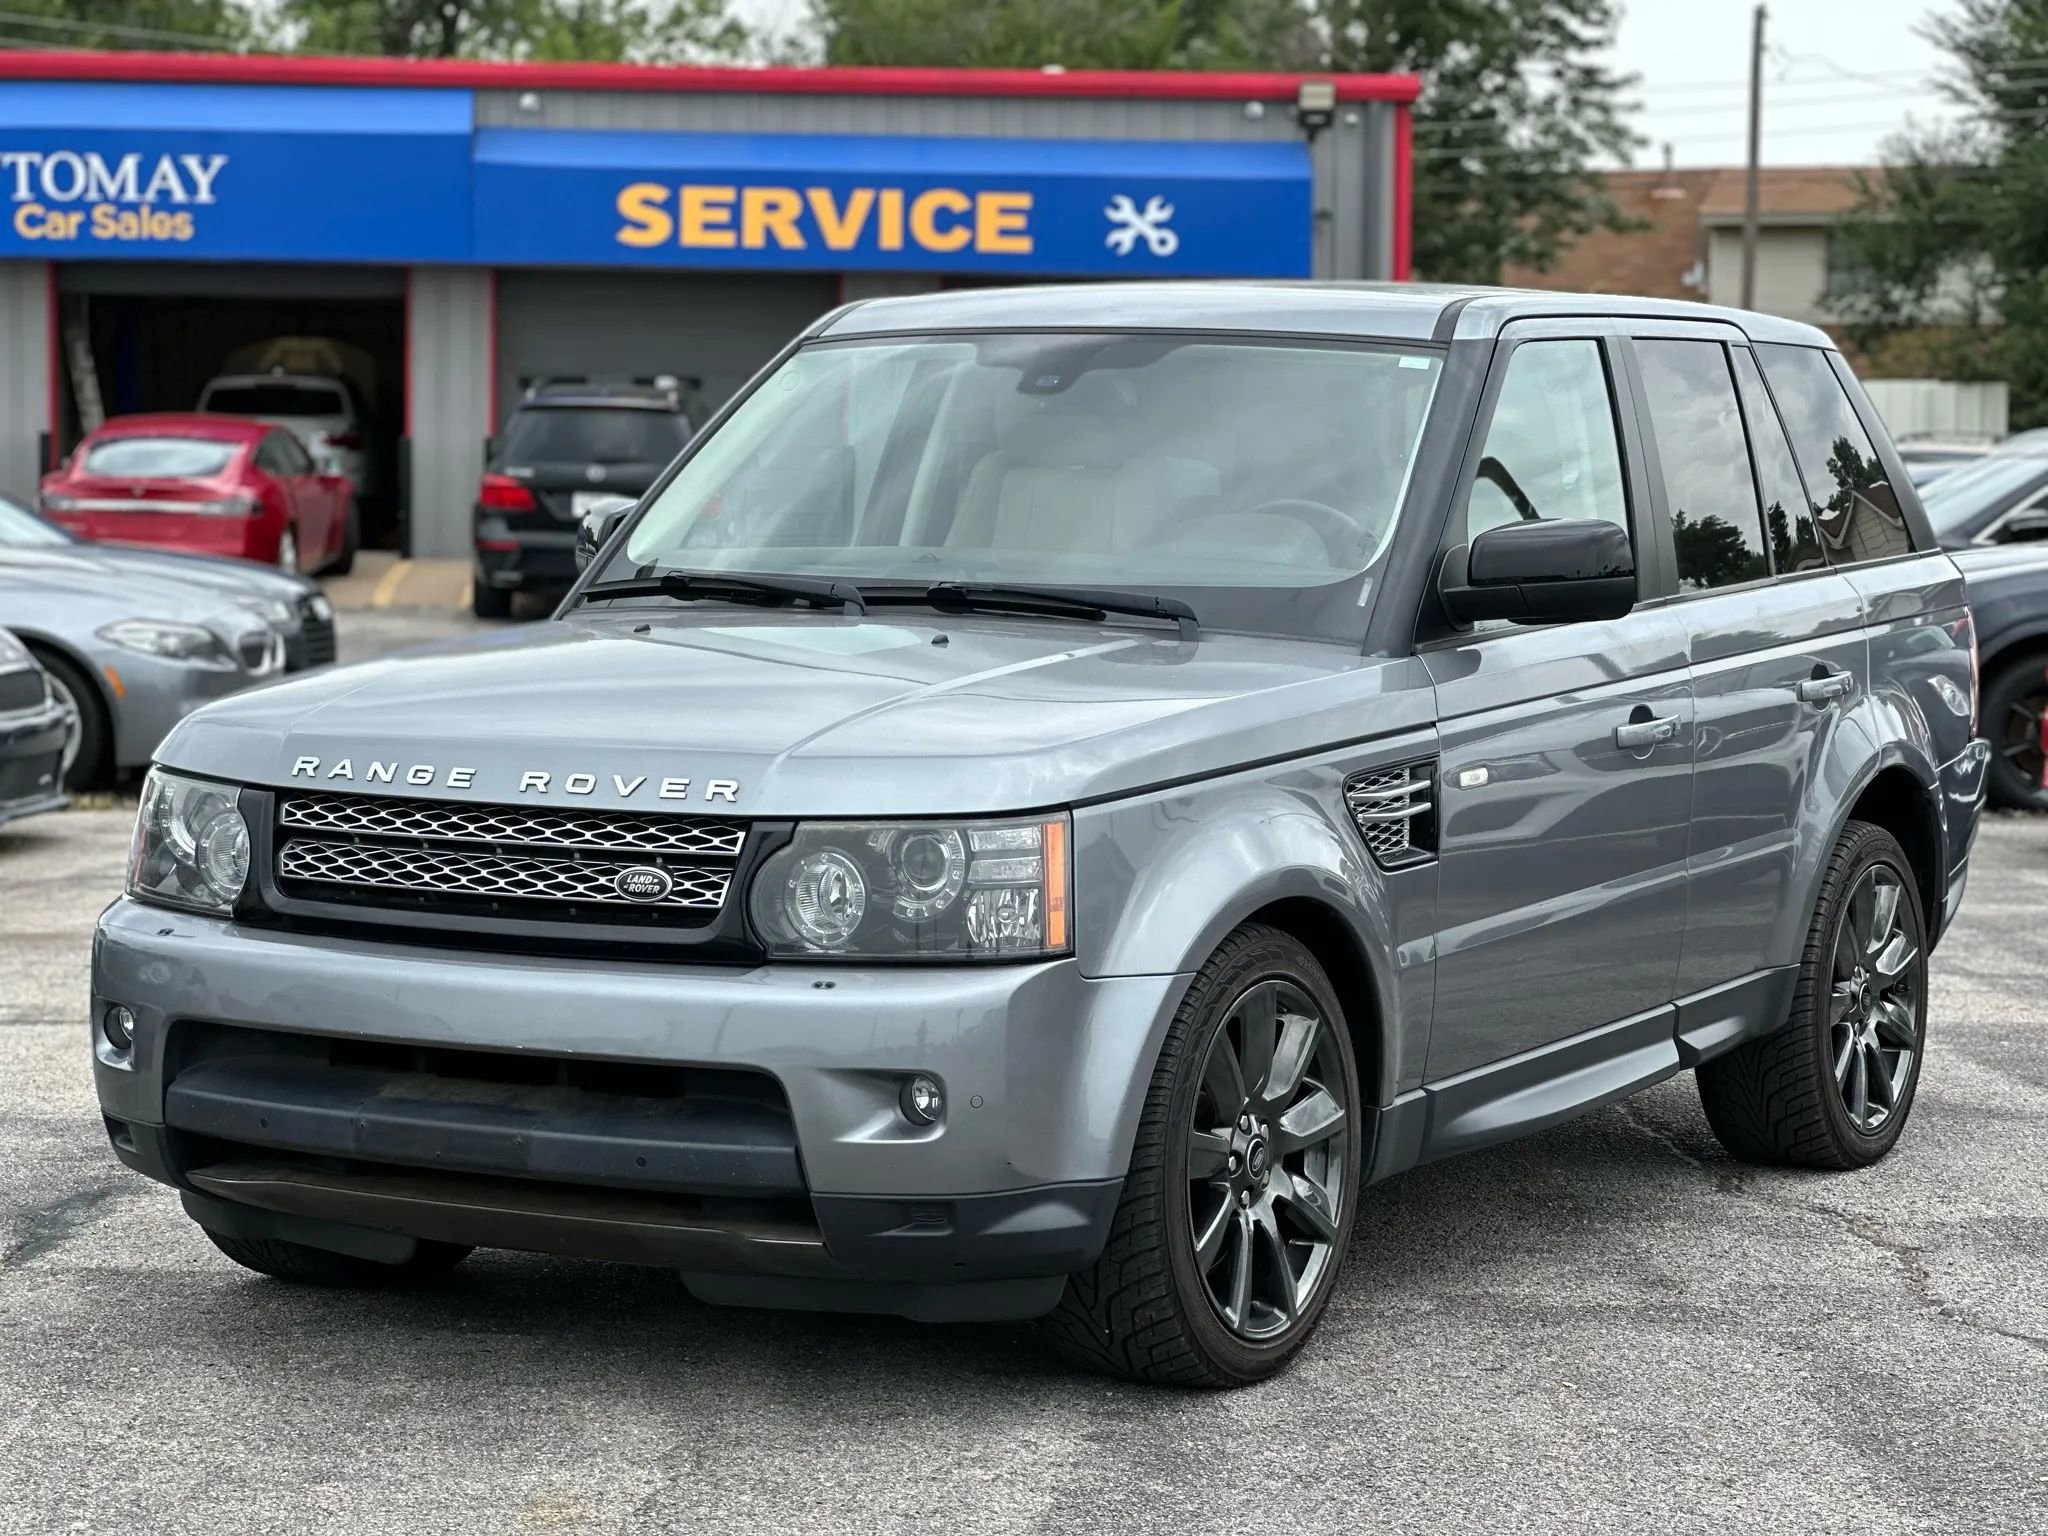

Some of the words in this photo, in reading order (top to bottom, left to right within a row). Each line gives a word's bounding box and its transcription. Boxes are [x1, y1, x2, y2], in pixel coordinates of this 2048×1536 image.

[0, 150, 229, 204] TOMAY
[14, 202, 85, 240] Car
[90, 202, 195, 241] Sales
[616, 182, 1034, 254] SERVICE
[291, 755, 477, 789] RANGE
[518, 770, 740, 803] ROVER
[626, 874, 654, 884] LAND
[627, 883, 661, 894] ROVER
